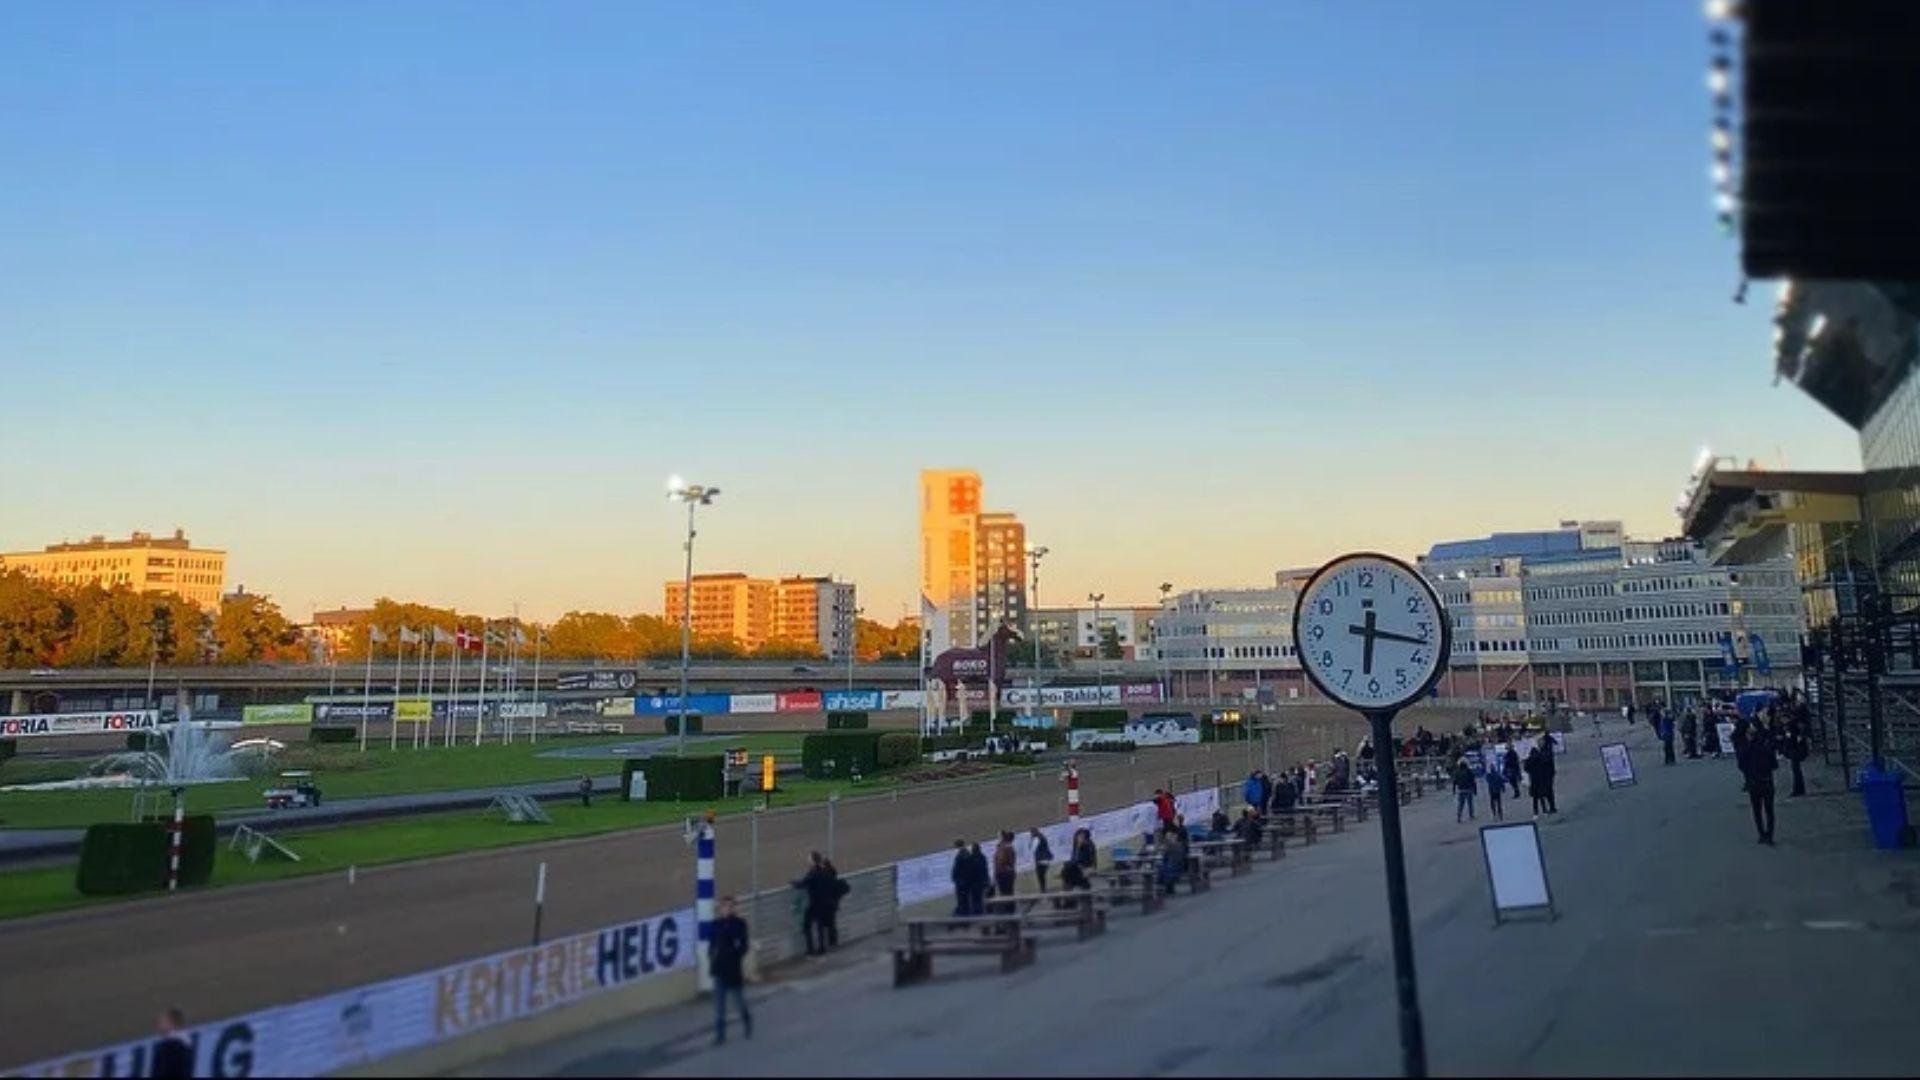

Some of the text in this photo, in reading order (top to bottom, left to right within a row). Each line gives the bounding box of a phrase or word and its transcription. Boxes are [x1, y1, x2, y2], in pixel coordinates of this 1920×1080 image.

[1336, 580, 1350, 597] 11
[1358, 572, 1374, 588] 12
[1389, 577, 1396, 595] 1
[1320, 598, 1334, 615] 10
[1407, 597, 1419, 614] 2
[1313, 624, 1325, 641] 9
[1416, 622, 1428, 639] 3
[1322, 650, 1333, 667] 8
[1410, 650, 1423, 664] 4
[1341, 669, 1353, 686] 7
[1395, 669, 1407, 684] 5
[1368, 678, 1380, 694] 6
[1, 718, 49, 735] FORIA
[104, 714, 154, 729] FORIA
